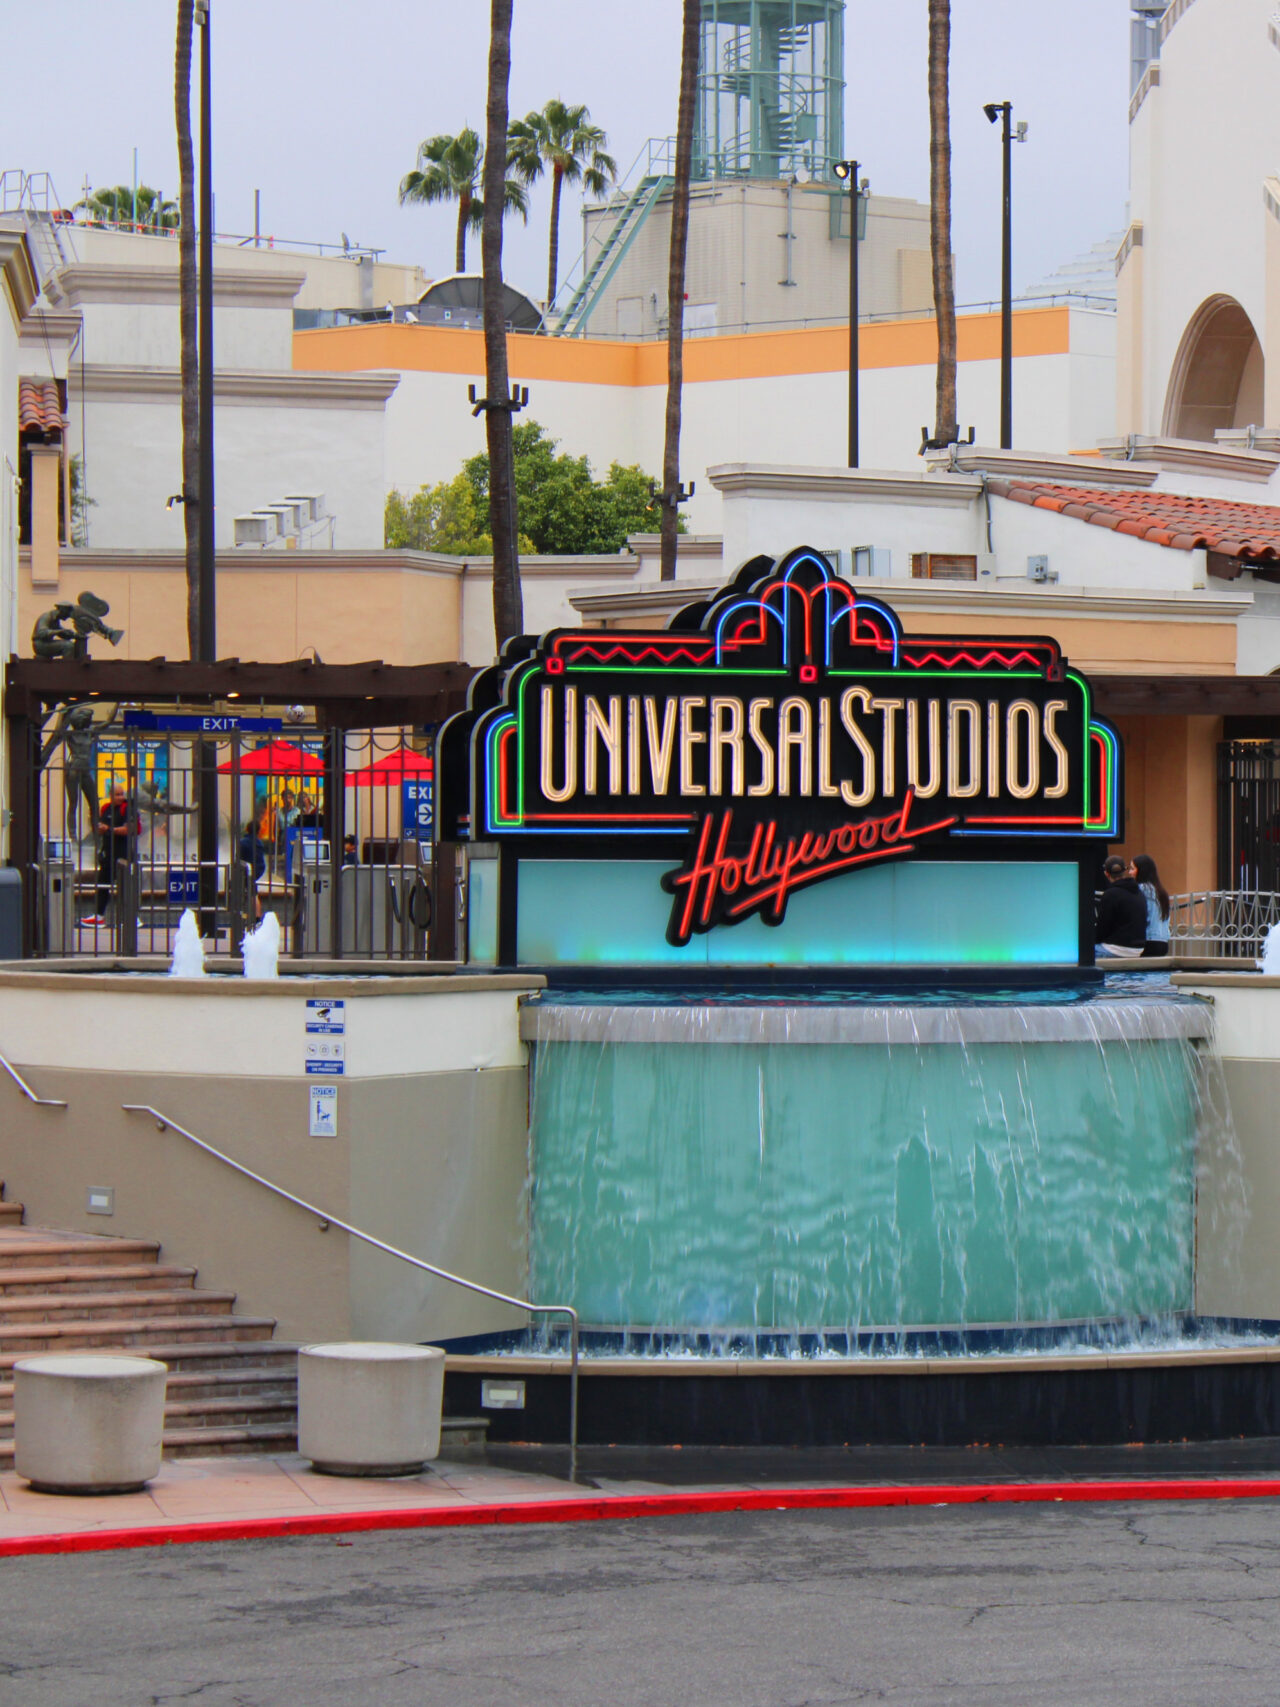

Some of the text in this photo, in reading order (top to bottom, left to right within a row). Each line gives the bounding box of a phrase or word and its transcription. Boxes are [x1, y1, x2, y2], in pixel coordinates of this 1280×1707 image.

[202, 718, 238, 730] EXIT
[540, 684, 1069, 807] UNIVERSAL STUDIOS
[408, 786, 432, 799] EXI
[670, 786, 958, 940] Hollywood
[170, 881, 198, 892] EXIT
[312, 1087, 336, 1095] NOTICE
